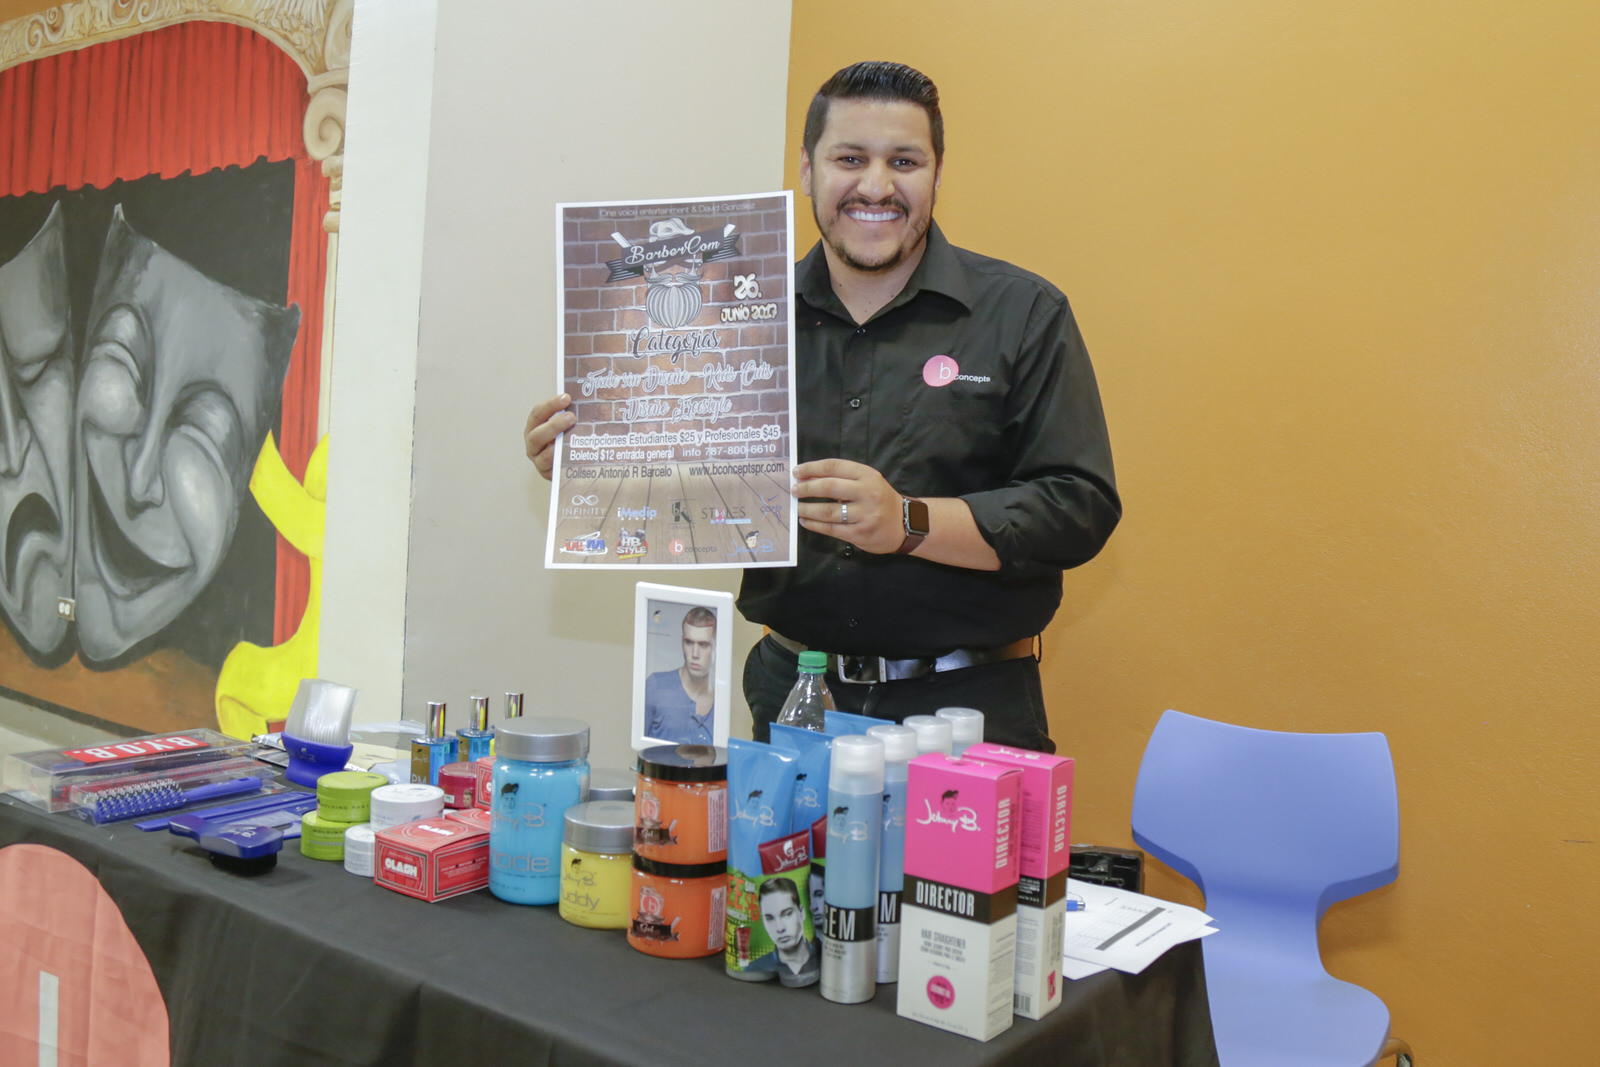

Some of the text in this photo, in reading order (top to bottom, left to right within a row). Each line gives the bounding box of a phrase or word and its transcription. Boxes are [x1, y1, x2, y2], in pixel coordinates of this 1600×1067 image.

[600, 208, 617, 217] One
[618, 207, 638, 217] voice
[639, 205, 690, 216] entertainment
[691, 205, 697, 213] &
[698, 203, 720, 213] David
[750, 302, 778, 321] 2017
[621, 372, 641, 388] sin
[739, 360, 774, 386] Cuts
[939, 361, 991, 384] b concepts
[570, 425, 780, 449] Inscripciones Estudiantes $25 y Profesionales $45
[570, 449, 598, 461] Boletos
[600, 449, 615, 461] $12
[616, 448, 646, 460] entrada
[646, 447, 675, 462] general
[704, 443, 776, 457] 787-800-6610
[565, 468, 597, 479] Coliseo
[633, 466, 639, 478] R
[689, 462, 785, 478] www.bconceptspr.com
[561, 507, 607, 516] INFINITY
[617, 506, 658, 518] iMedia
[616, 546, 647, 554] STYLE
[621, 537, 642, 547] HB
[684, 545, 718, 553] concepts
[915, 798, 959, 833] Johnny
[1054, 785, 1068, 853] DIRECTOR
[995, 798, 1011, 869] DIRECTOR
[915, 880, 976, 917] DIRECTOR
